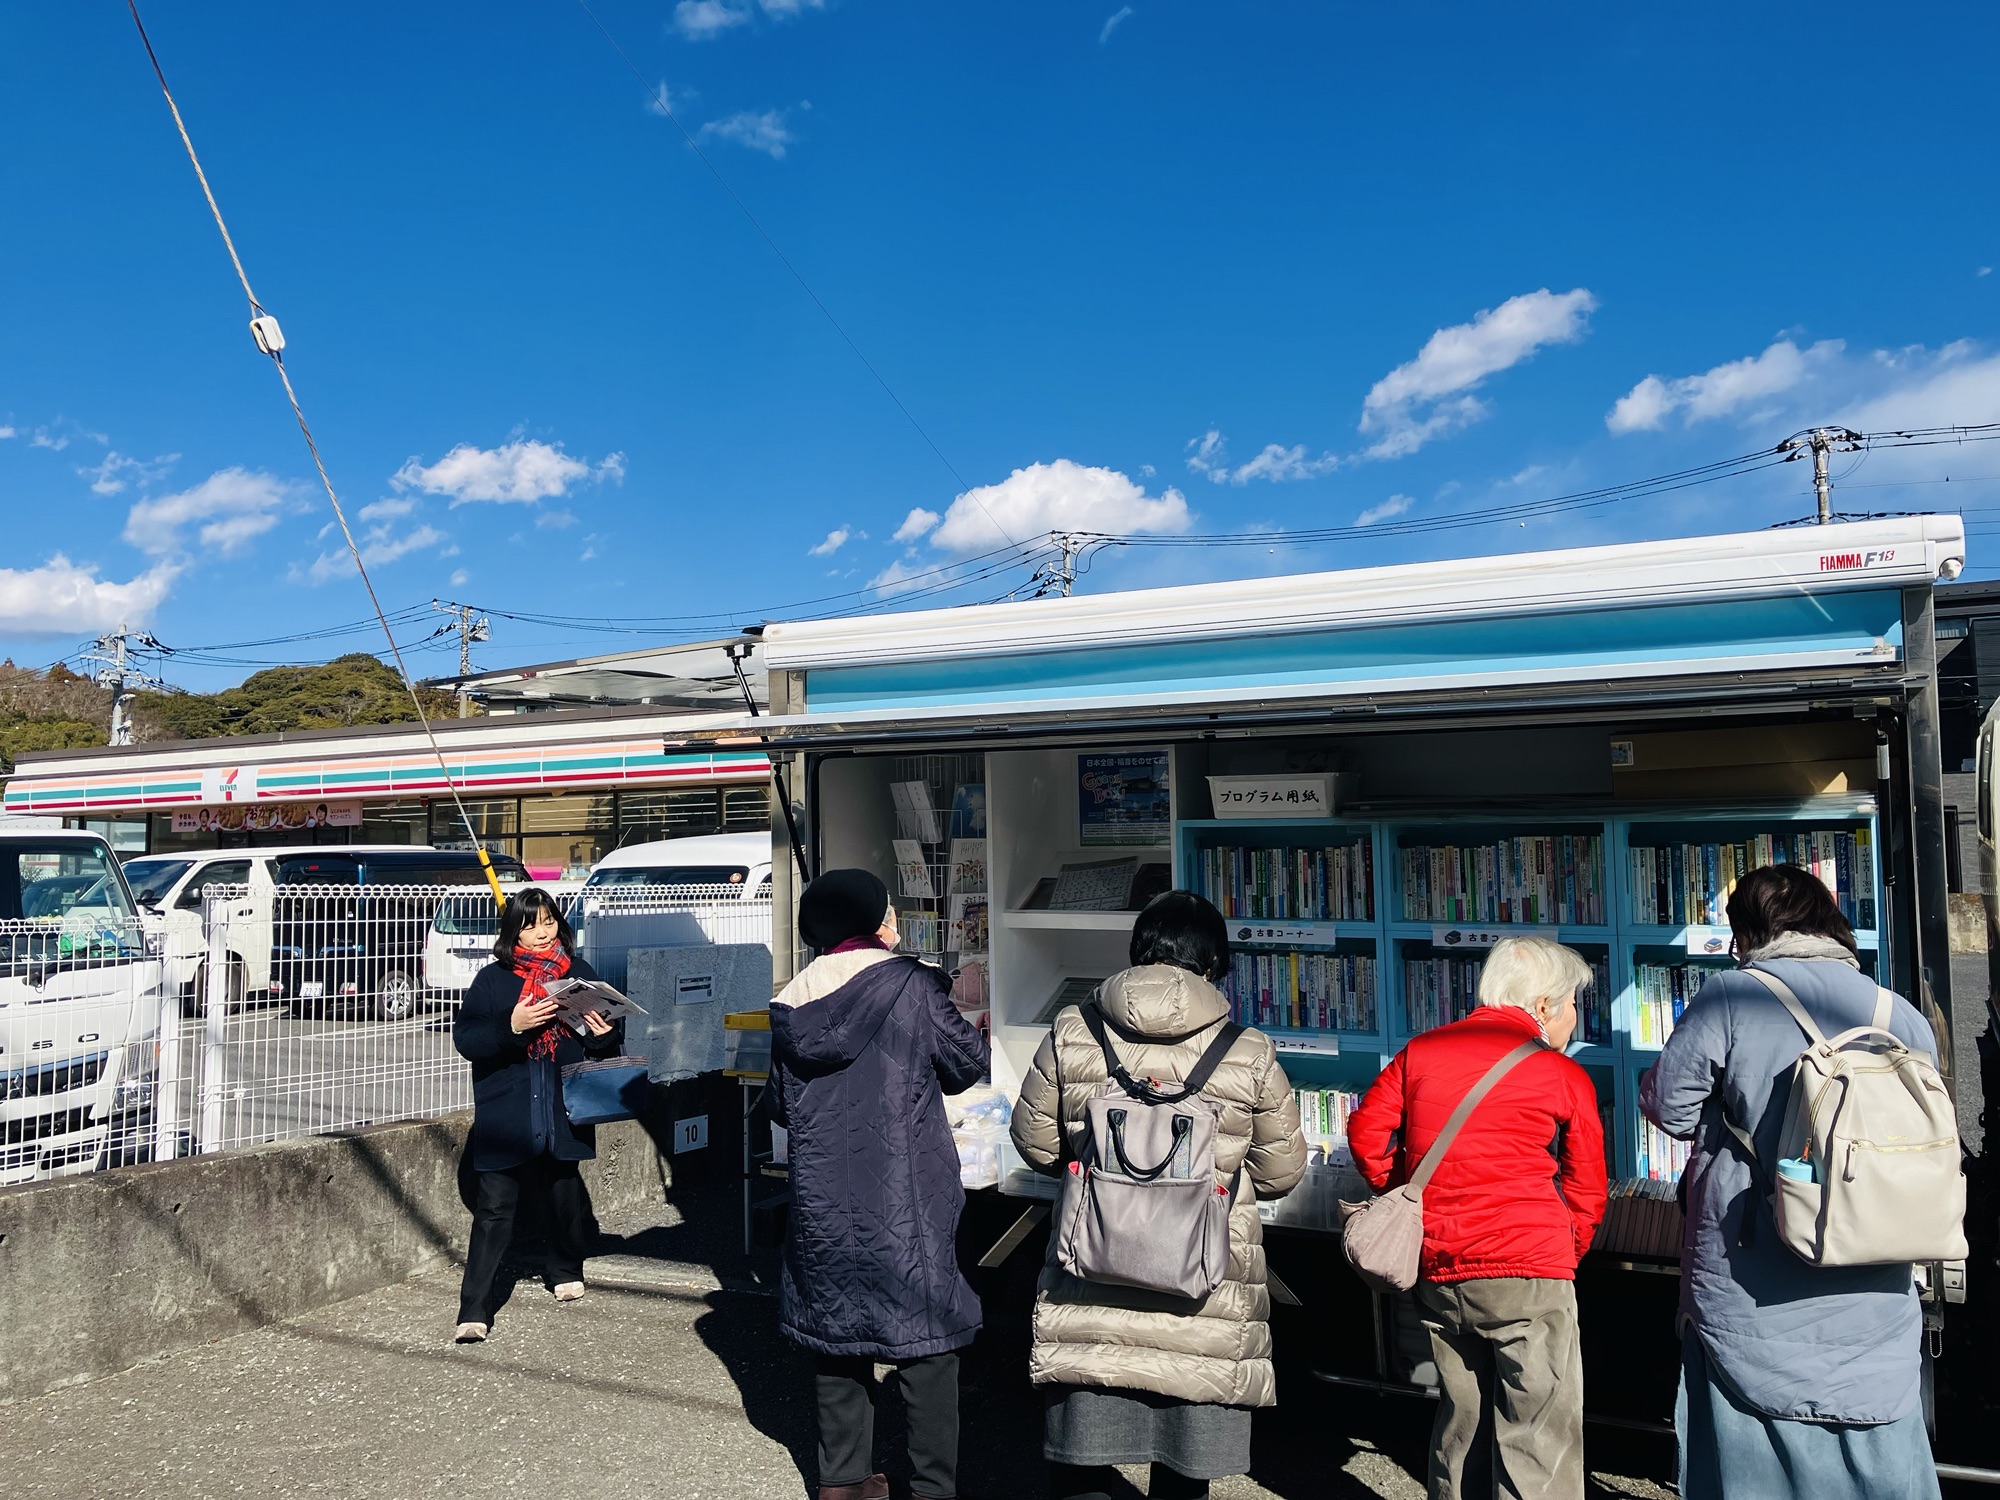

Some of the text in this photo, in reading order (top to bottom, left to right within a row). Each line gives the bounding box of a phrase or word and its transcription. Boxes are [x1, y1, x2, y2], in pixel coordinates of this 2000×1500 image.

[1820, 553, 1862, 571] FIAMMA
[1220, 789, 1320, 804] プログラム用紙
[1256, 929, 1314, 939] 古書コーナー
[684, 1124, 698, 1145] 10
